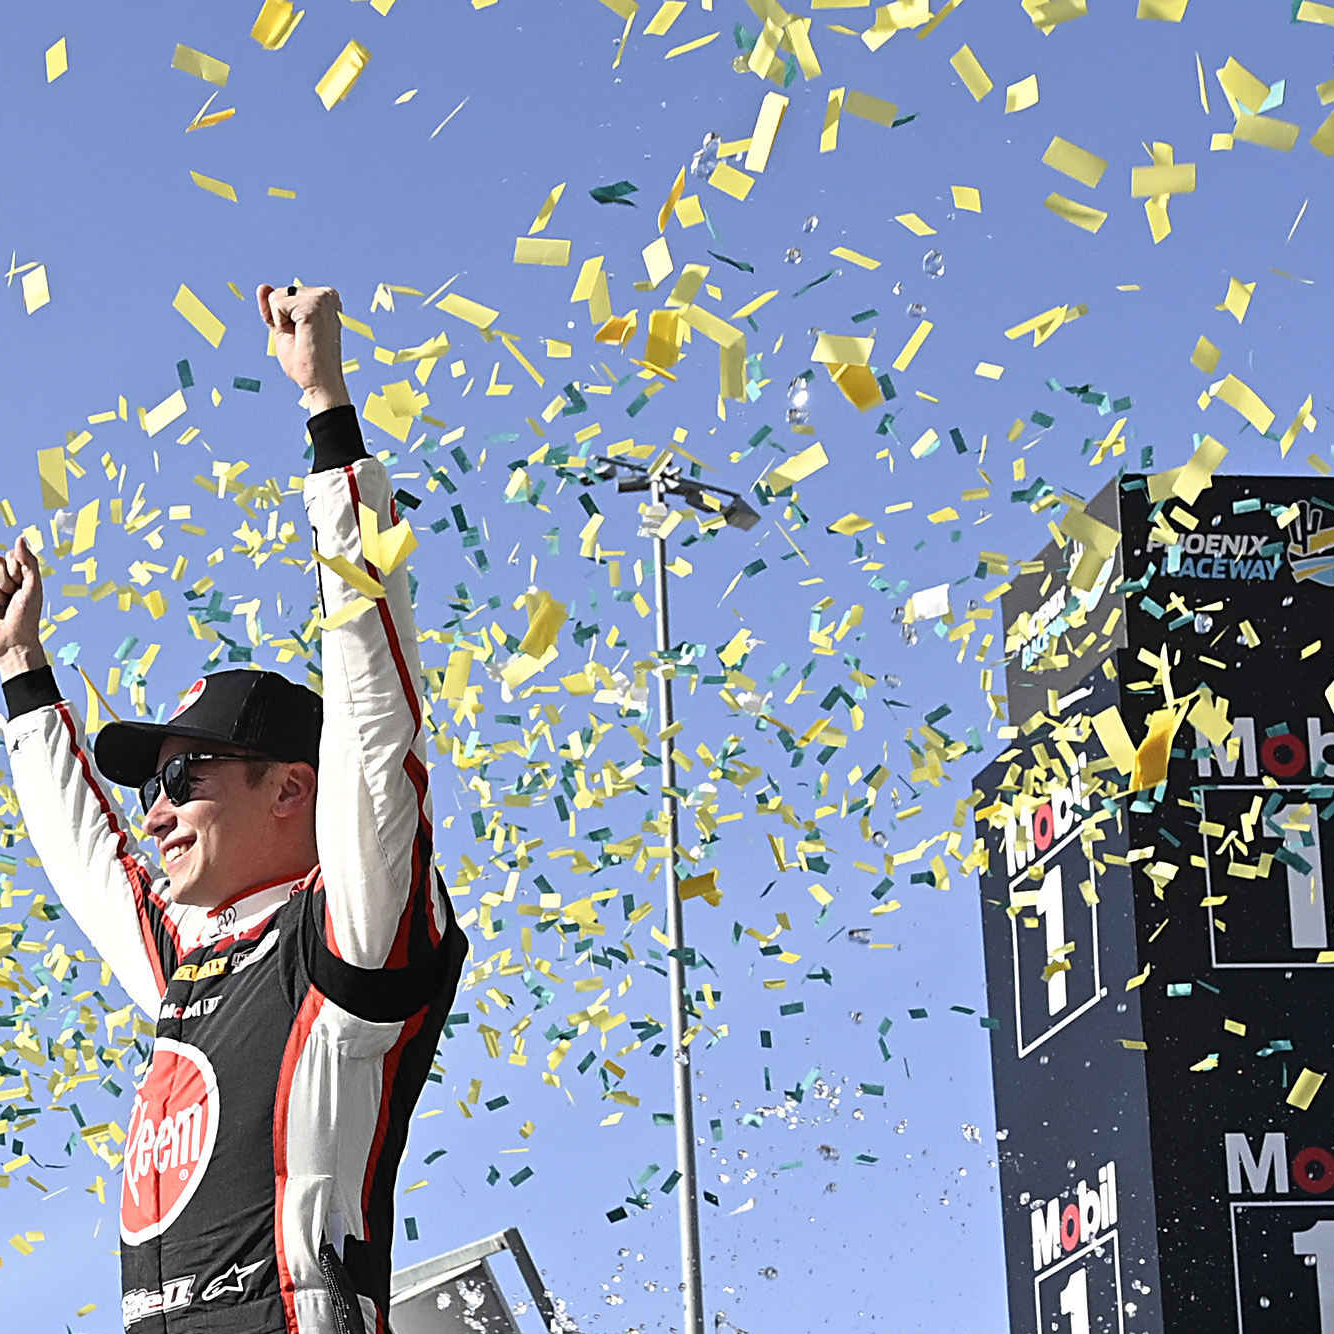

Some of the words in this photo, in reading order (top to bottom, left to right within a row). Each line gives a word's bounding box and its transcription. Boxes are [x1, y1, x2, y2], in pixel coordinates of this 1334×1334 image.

[1036, 865, 1067, 1016] 1
[1261, 804, 1328, 948] 1
[1031, 1161, 1118, 1271] Mobil
